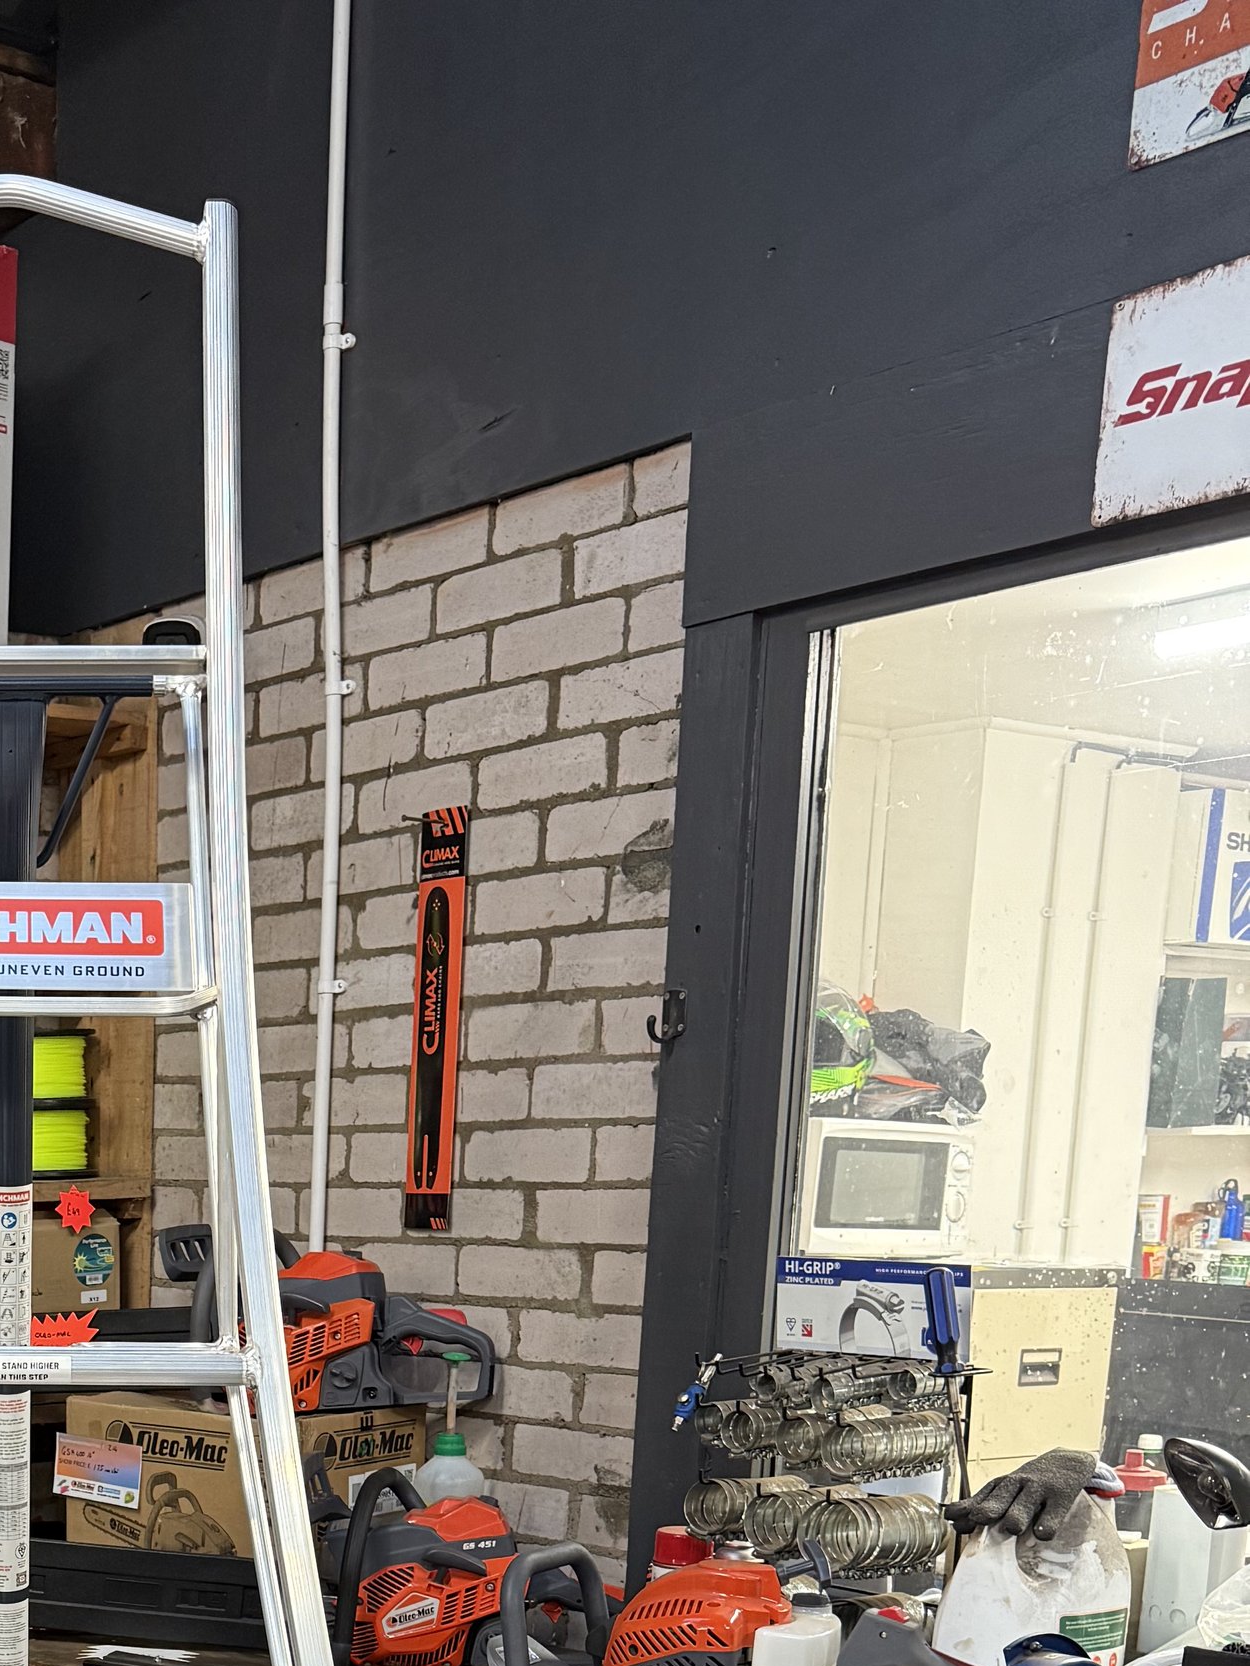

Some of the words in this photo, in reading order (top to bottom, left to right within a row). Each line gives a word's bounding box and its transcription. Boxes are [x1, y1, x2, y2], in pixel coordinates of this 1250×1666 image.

[422, 845, 459, 869] CLIMAX
[72, 965, 146, 978] GROUND
[422, 967, 440, 1055] CLIMAX
[785, 1276, 804, 1284] ZINC
[805, 1277, 834, 1285] PLATED
[2, 1362, 28, 1370] STAND
[30, 1362, 59, 1370] HIGHER
[9, 1373, 26, 1381] THIS
[29, 1373, 49, 1381] STEP
[462, 1542, 475, 1550] GS
[477, 1540, 497, 1549] 451
[398, 1606, 435, 1624] Oleo-Mac
